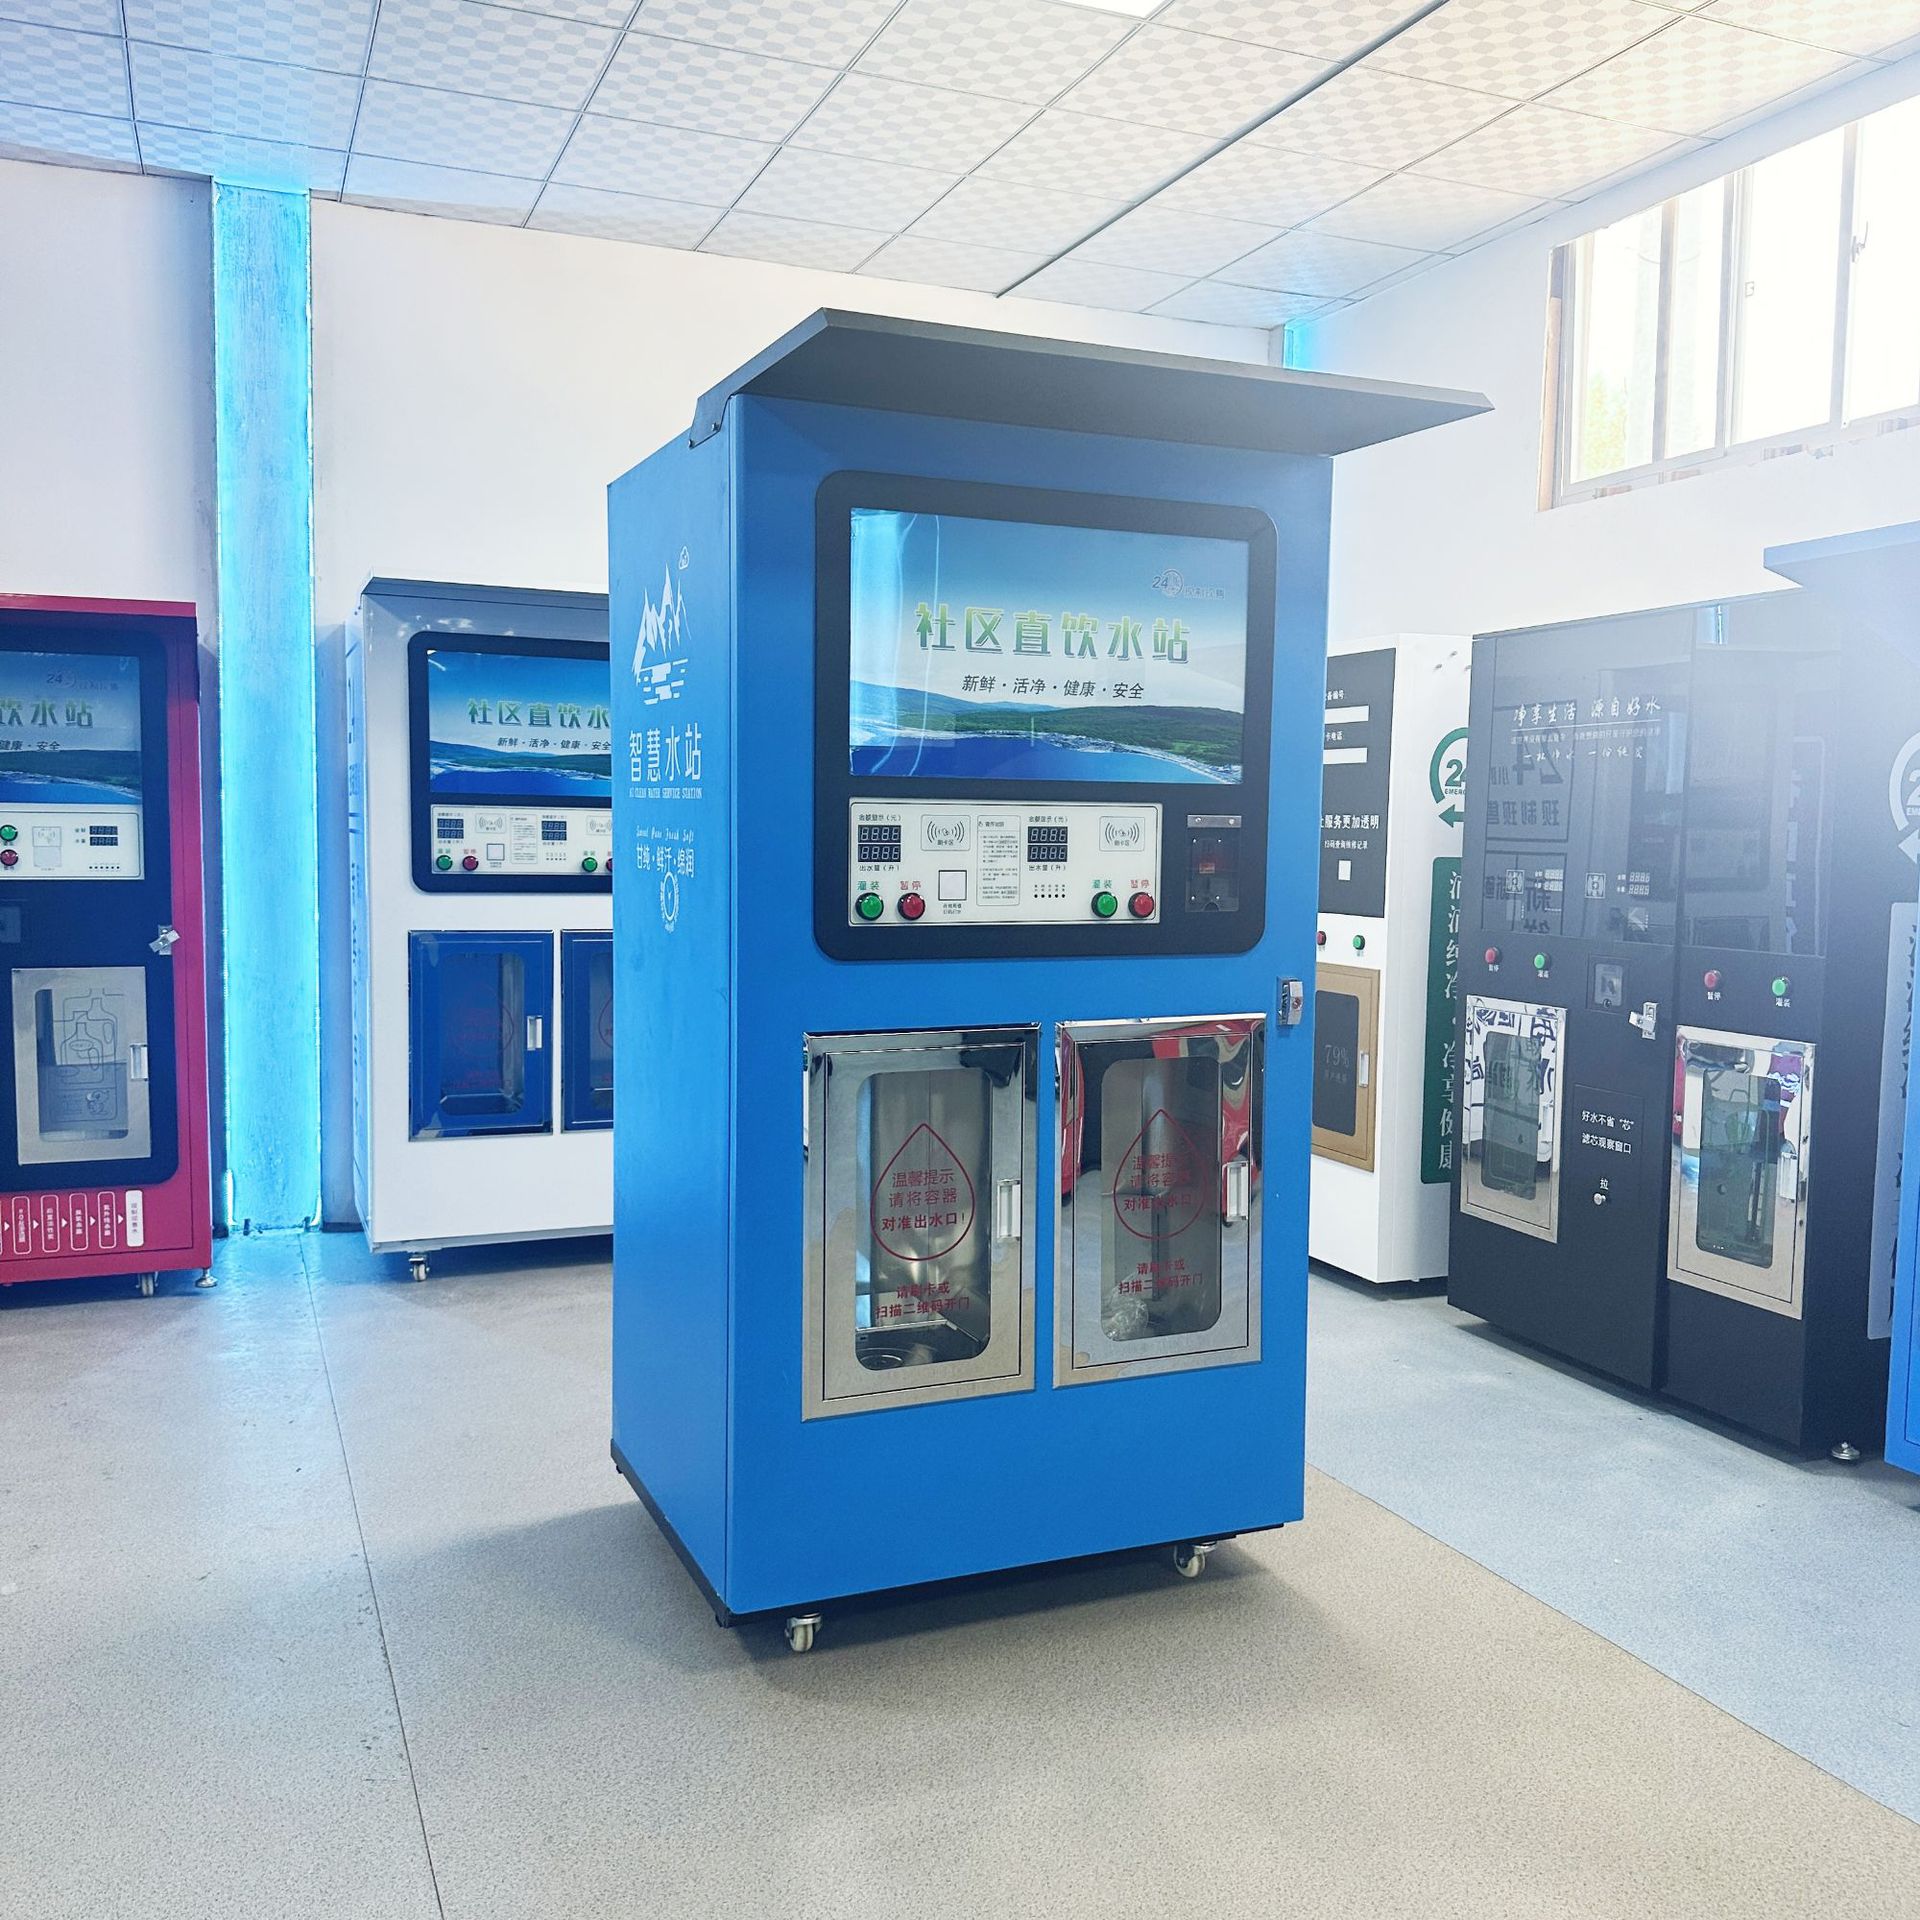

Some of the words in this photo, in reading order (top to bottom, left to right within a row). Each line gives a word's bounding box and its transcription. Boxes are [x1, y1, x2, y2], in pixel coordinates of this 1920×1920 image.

[915, 602, 1189, 664] 社区直饮水站
[629, 722, 702, 783] 智慧水站
[661, 787, 681, 799] SERVICE
[681, 787, 702, 800] STATION
[900, 880, 921, 891] 暂停
[1581, 1132, 1632, 1154] 滤芯观察窗口
[892, 1167, 955, 1188] 温馨提示
[889, 1187, 957, 1209] 请将容器
[875, 1295, 971, 1320] 扫描二维码开门
